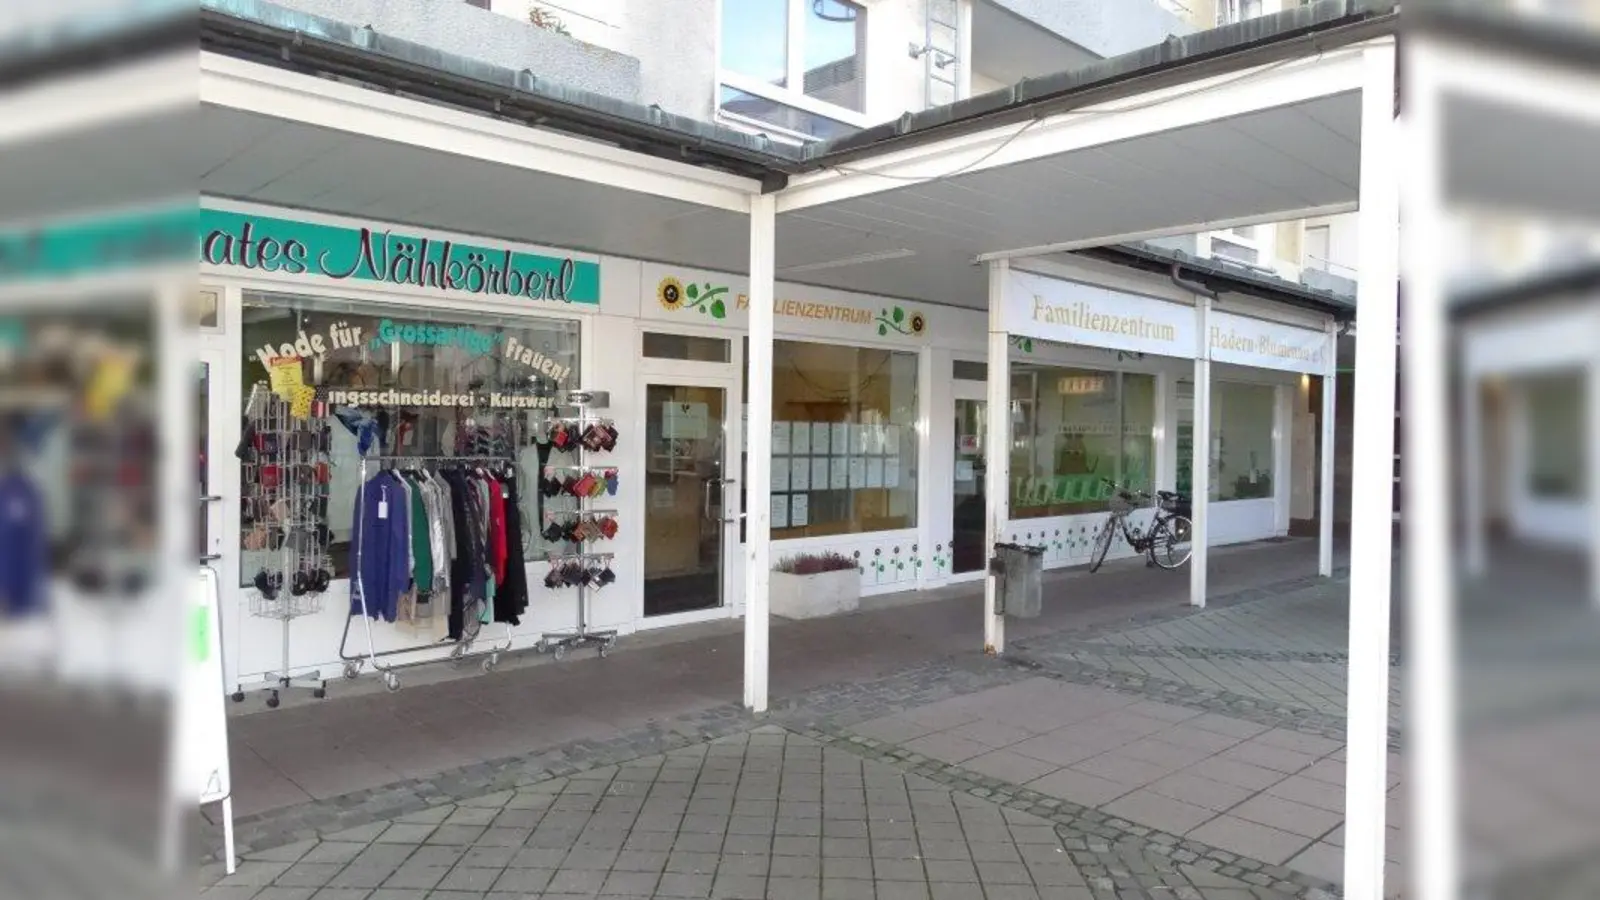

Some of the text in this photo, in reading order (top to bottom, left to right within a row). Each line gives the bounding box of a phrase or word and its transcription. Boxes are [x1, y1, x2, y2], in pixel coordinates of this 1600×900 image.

[200, 221, 574, 304] ates Nähkörberl
[736, 293, 872, 324] FALIENZENTRUM
[1032, 295, 1175, 341] Familienzentrum
[329, 321, 362, 350] für
[505, 336, 571, 383] Frauen!
[490, 390, 555, 408] Kurzwar
